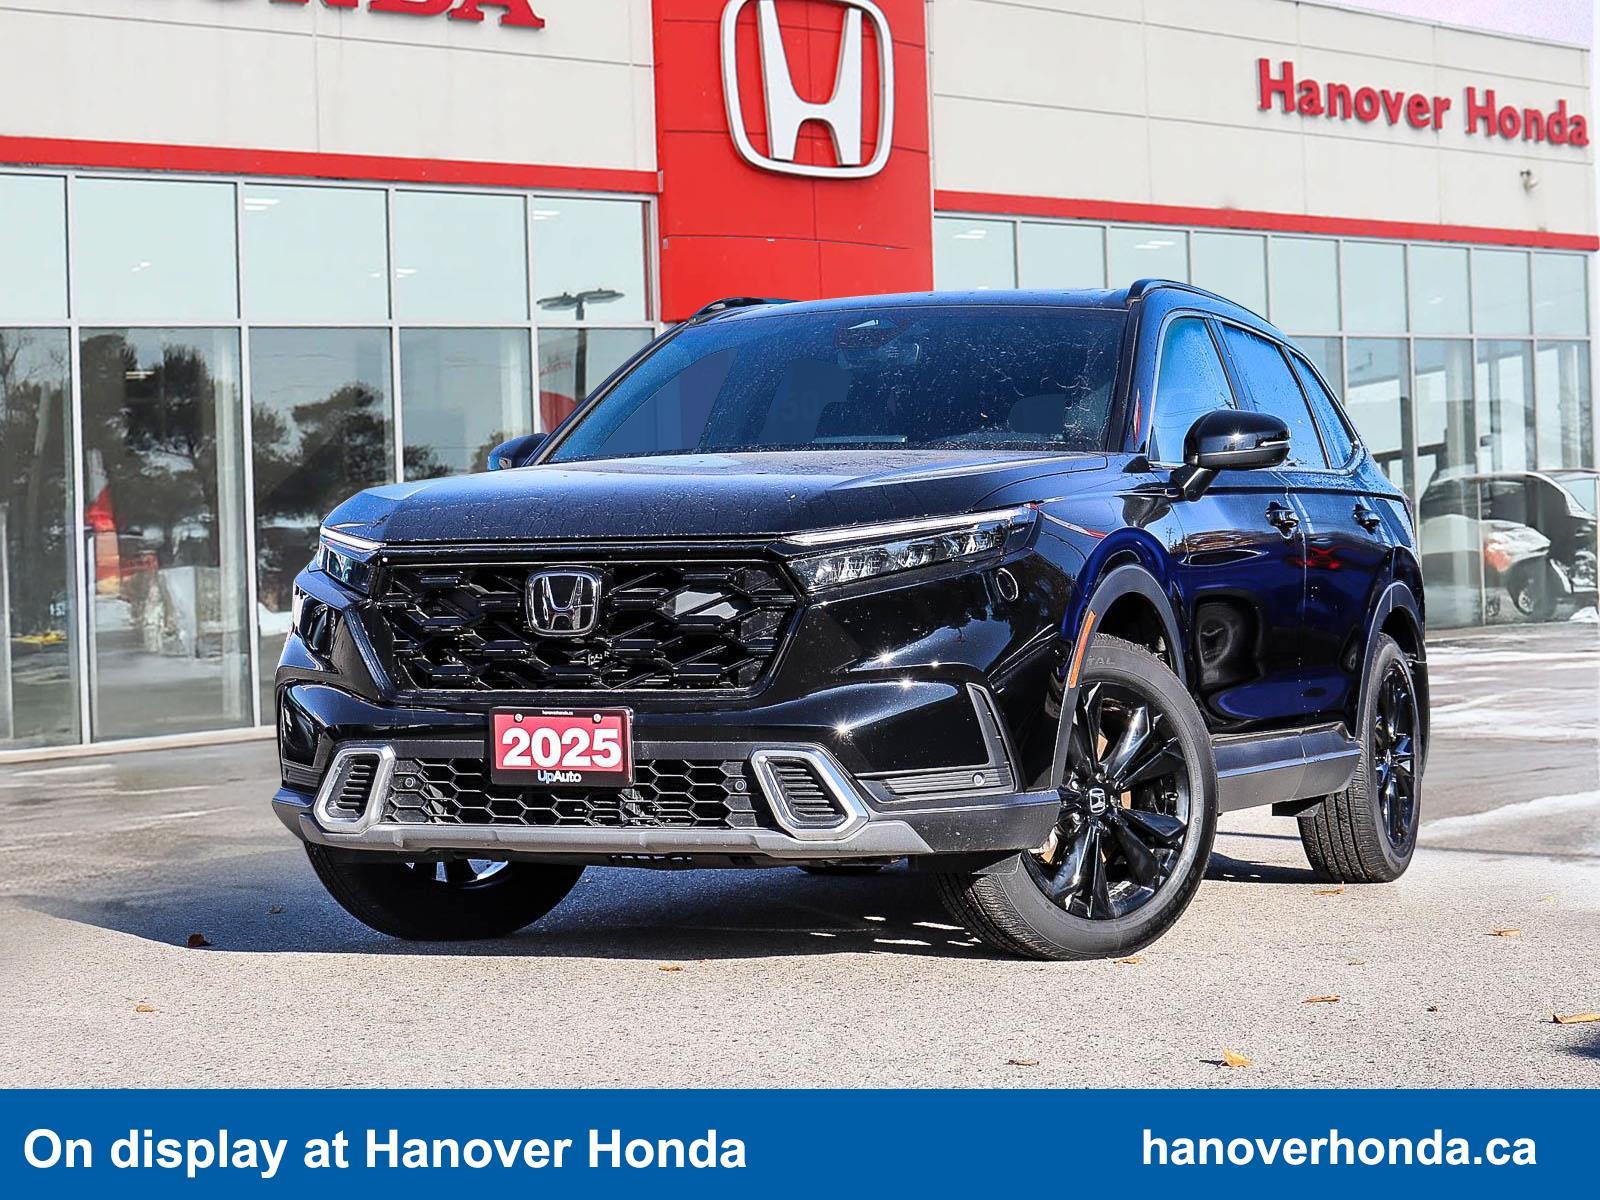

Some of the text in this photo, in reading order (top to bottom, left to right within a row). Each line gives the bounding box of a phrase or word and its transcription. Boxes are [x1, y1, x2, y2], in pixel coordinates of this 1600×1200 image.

[1257, 57, 1589, 147] Hanover Honda
[502, 727, 622, 768] 2025
[537, 770, 582, 784] UpAuto
